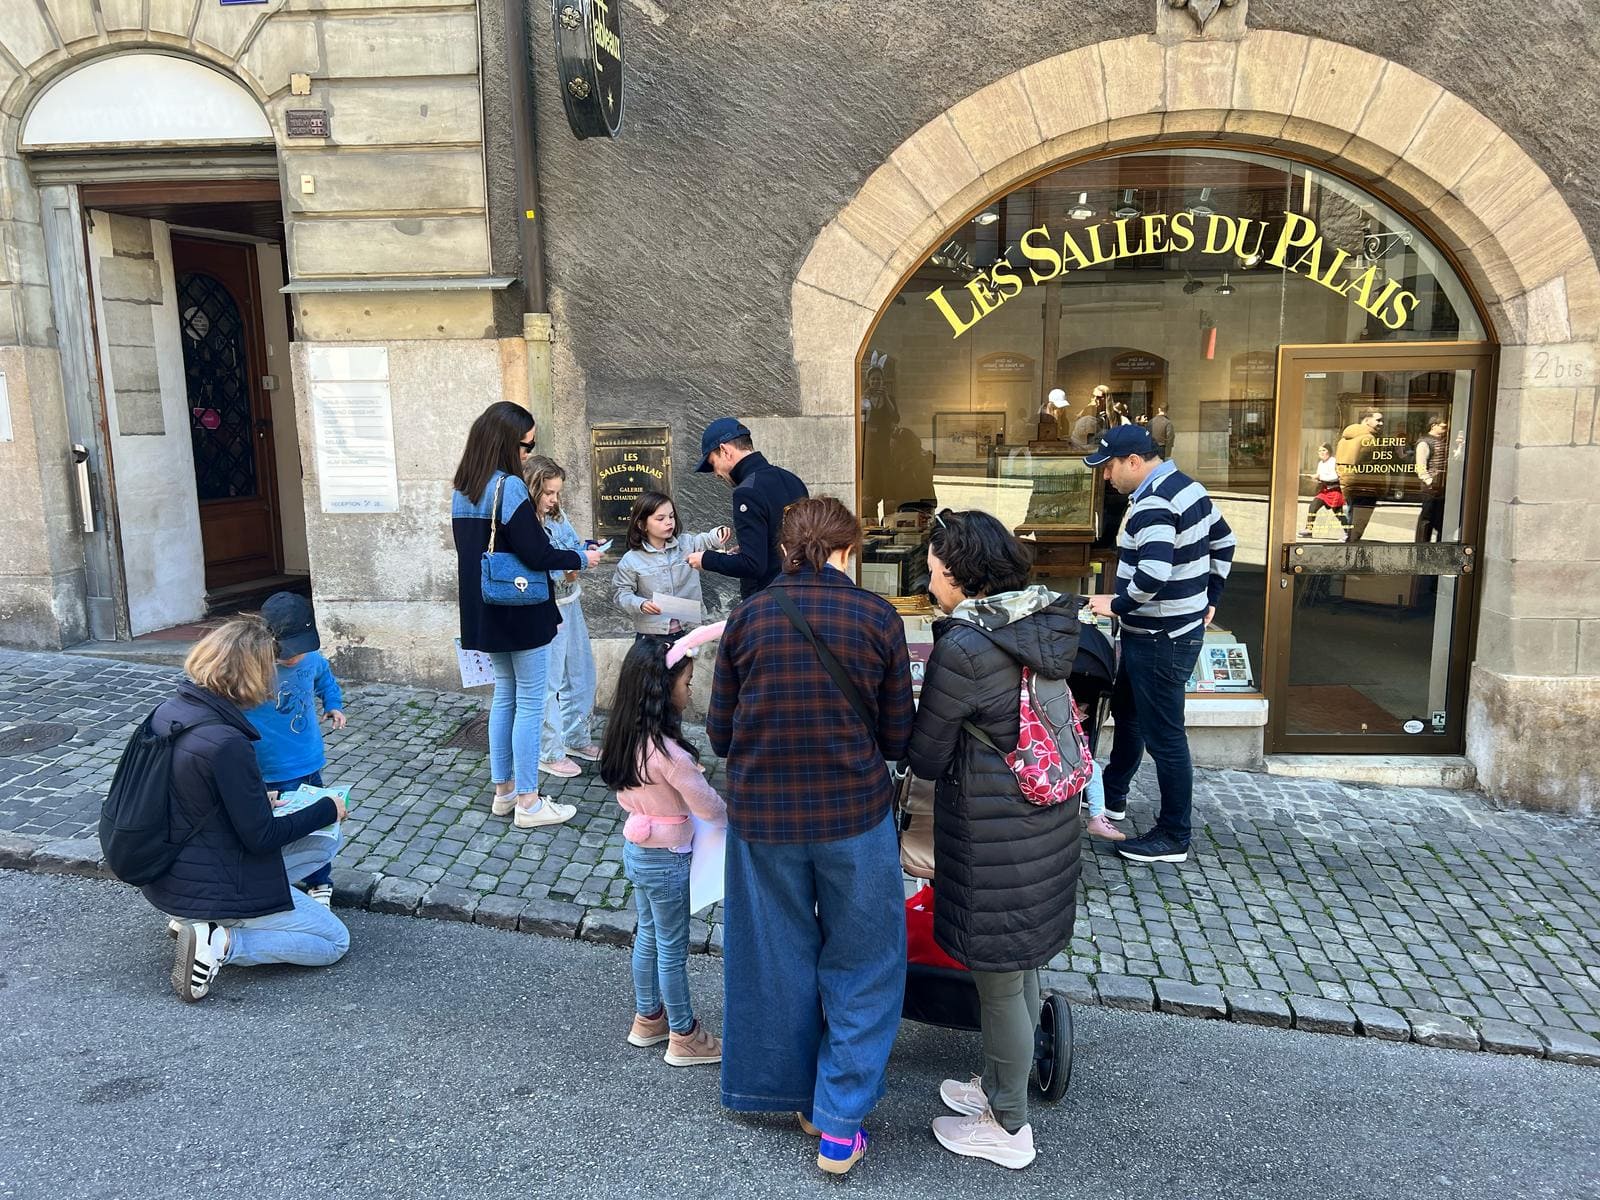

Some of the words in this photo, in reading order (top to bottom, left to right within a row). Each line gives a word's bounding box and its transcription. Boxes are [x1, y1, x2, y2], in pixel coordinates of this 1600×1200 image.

[926, 259, 1023, 339] LES
[1020, 212, 1195, 286] SALLES
[1201, 214, 1270, 259] DU
[1265, 211, 1420, 329] PALAIS
[1533, 351, 1550, 379] 2
[1554, 356, 1584, 378] bis
[1361, 437, 1406, 447] GALERIE
[624, 453, 638, 461] LES
[1372, 451, 1393, 460] DES
[599, 464, 627, 479] SALLES
[635, 464, 663, 479] PALAIS
